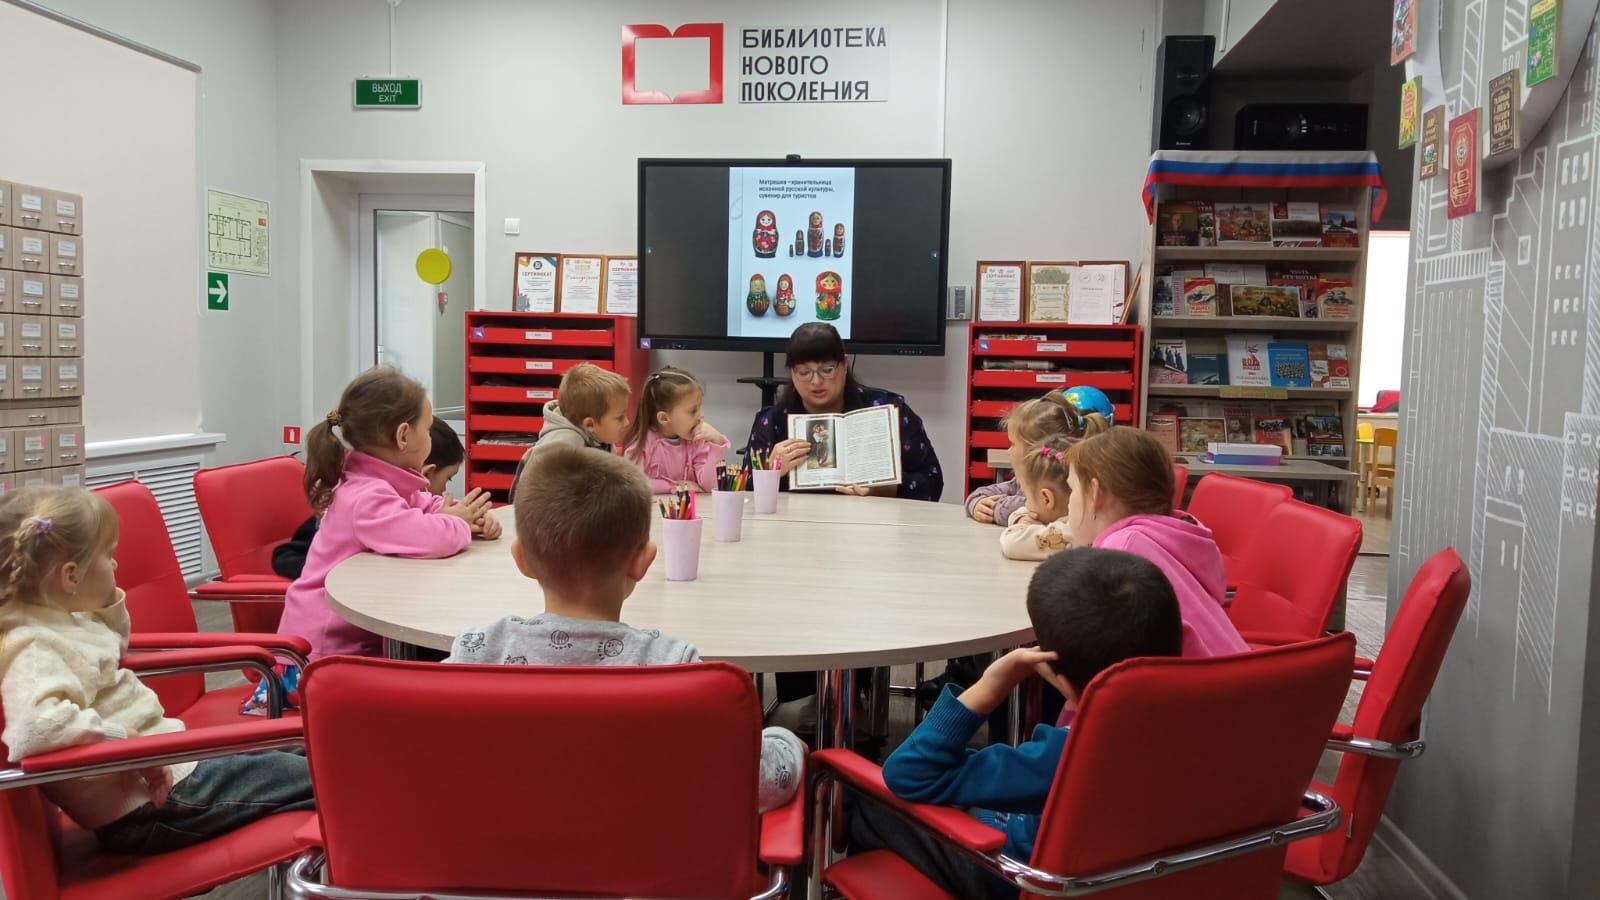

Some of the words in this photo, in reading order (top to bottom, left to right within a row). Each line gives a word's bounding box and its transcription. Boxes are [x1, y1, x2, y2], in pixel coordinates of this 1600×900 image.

[743, 28, 886, 48] БИБЛИОТЕКА
[742, 55, 829, 75] НОВОГО
[372, 83, 402, 94] ВЫХОД
[379, 94, 396, 102] EXIT
[742, 81, 869, 101] ПОКОЛЕНИЯ
